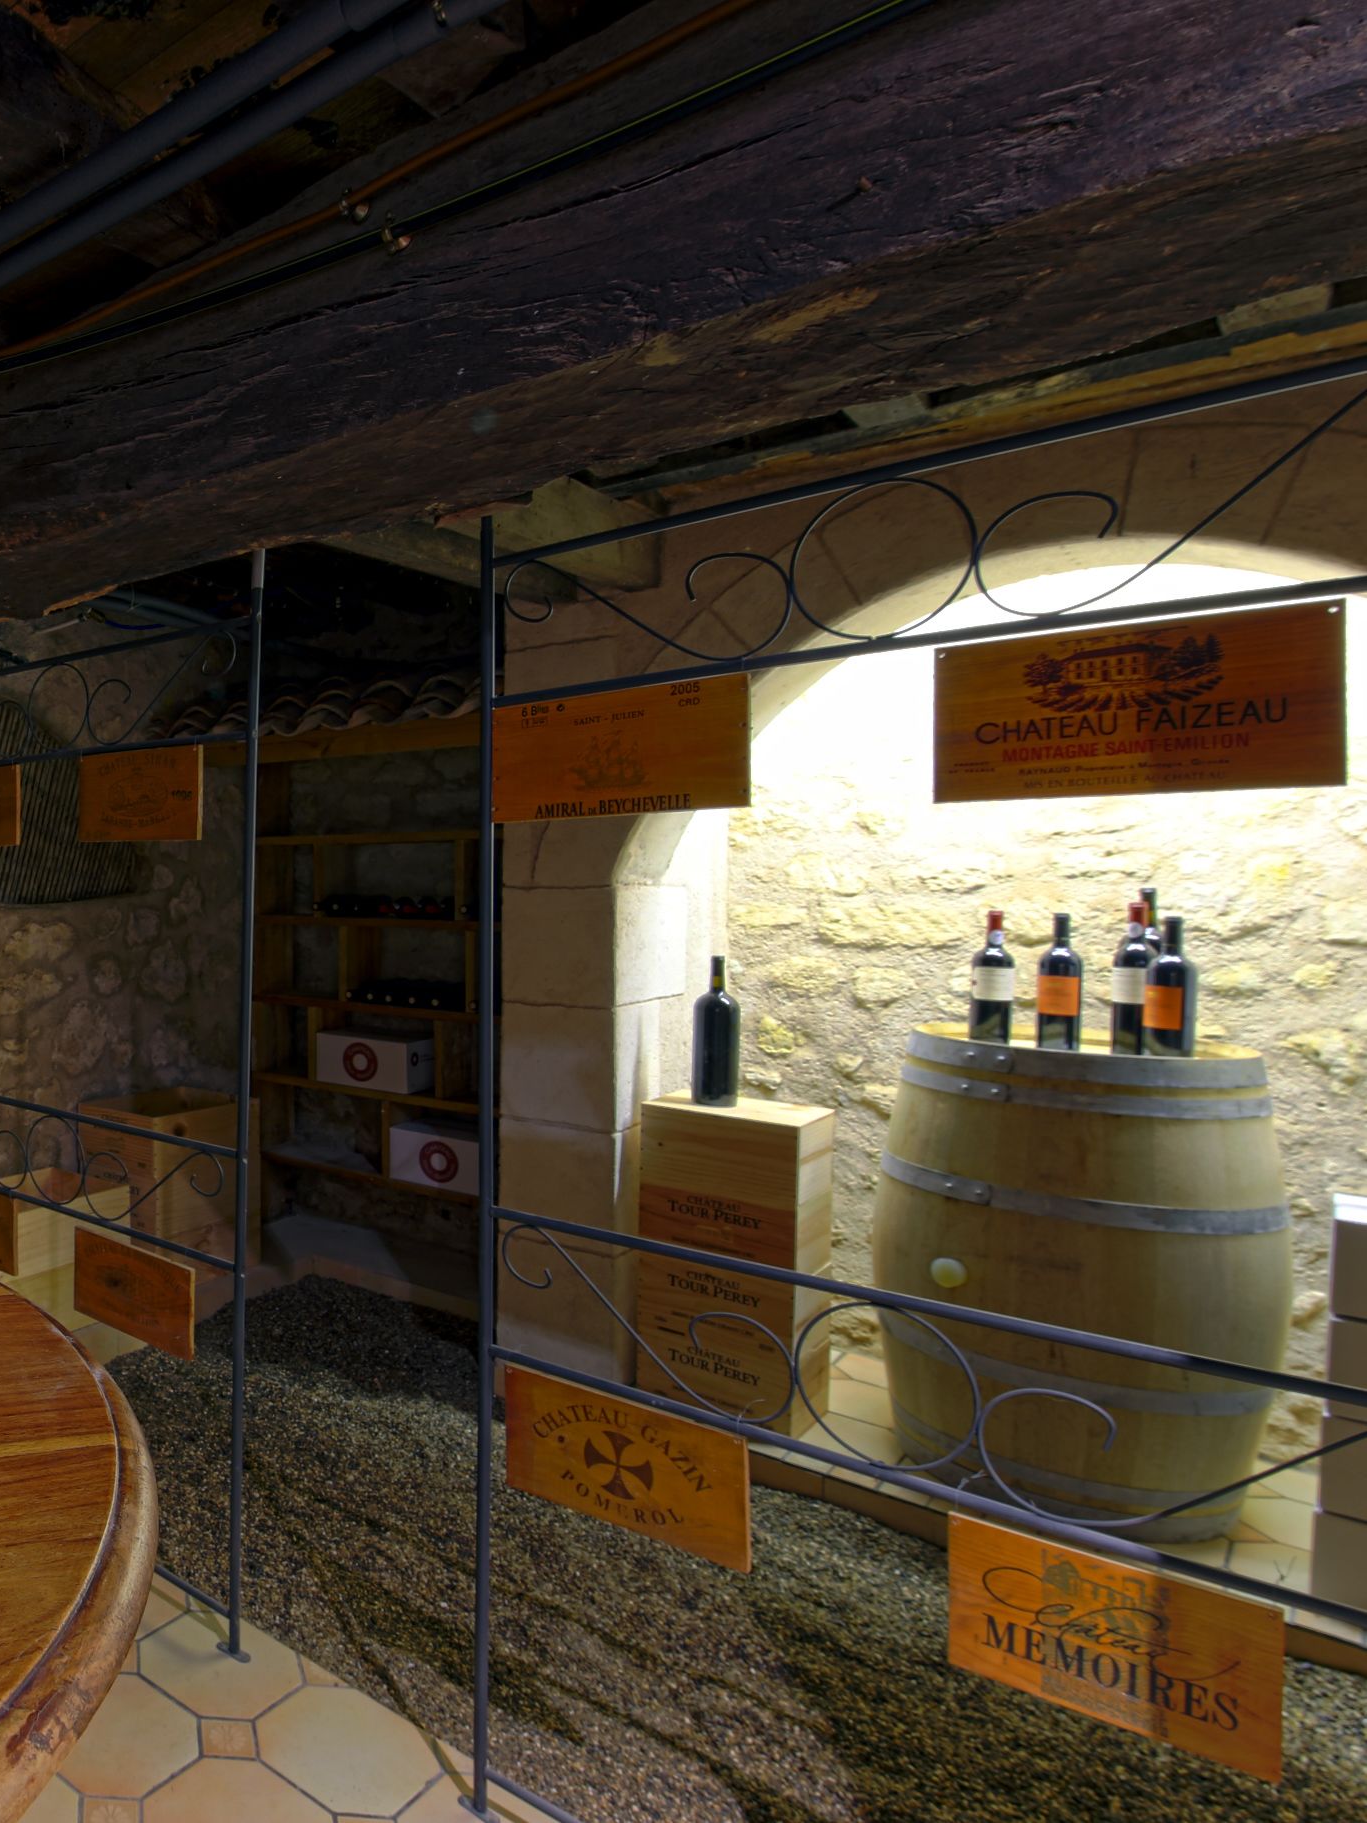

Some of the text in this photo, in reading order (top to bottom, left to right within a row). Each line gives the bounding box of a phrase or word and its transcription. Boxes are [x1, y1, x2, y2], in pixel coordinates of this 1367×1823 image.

[670, 682, 700, 696] 2005
[610, 710, 645, 724] JULIEN
[975, 697, 1289, 745] CHATEAU FAIZEAU
[1002, 743, 1099, 763] MONTAGNE
[534, 802, 585, 818] AMIRAL
[599, 793, 691, 815] BEYCHEVELLE
[667, 1199, 762, 1230] TOUR PEREY
[667, 1273, 761, 1308] TOUR PEREY
[667, 1347, 761, 1386] TOUR PEREY
[532, 1404, 713, 1493] CHATEAU GAZIN
[560, 1469, 685, 1526] POMEROL
[981, 1612, 1240, 1732] MEMOIRES
